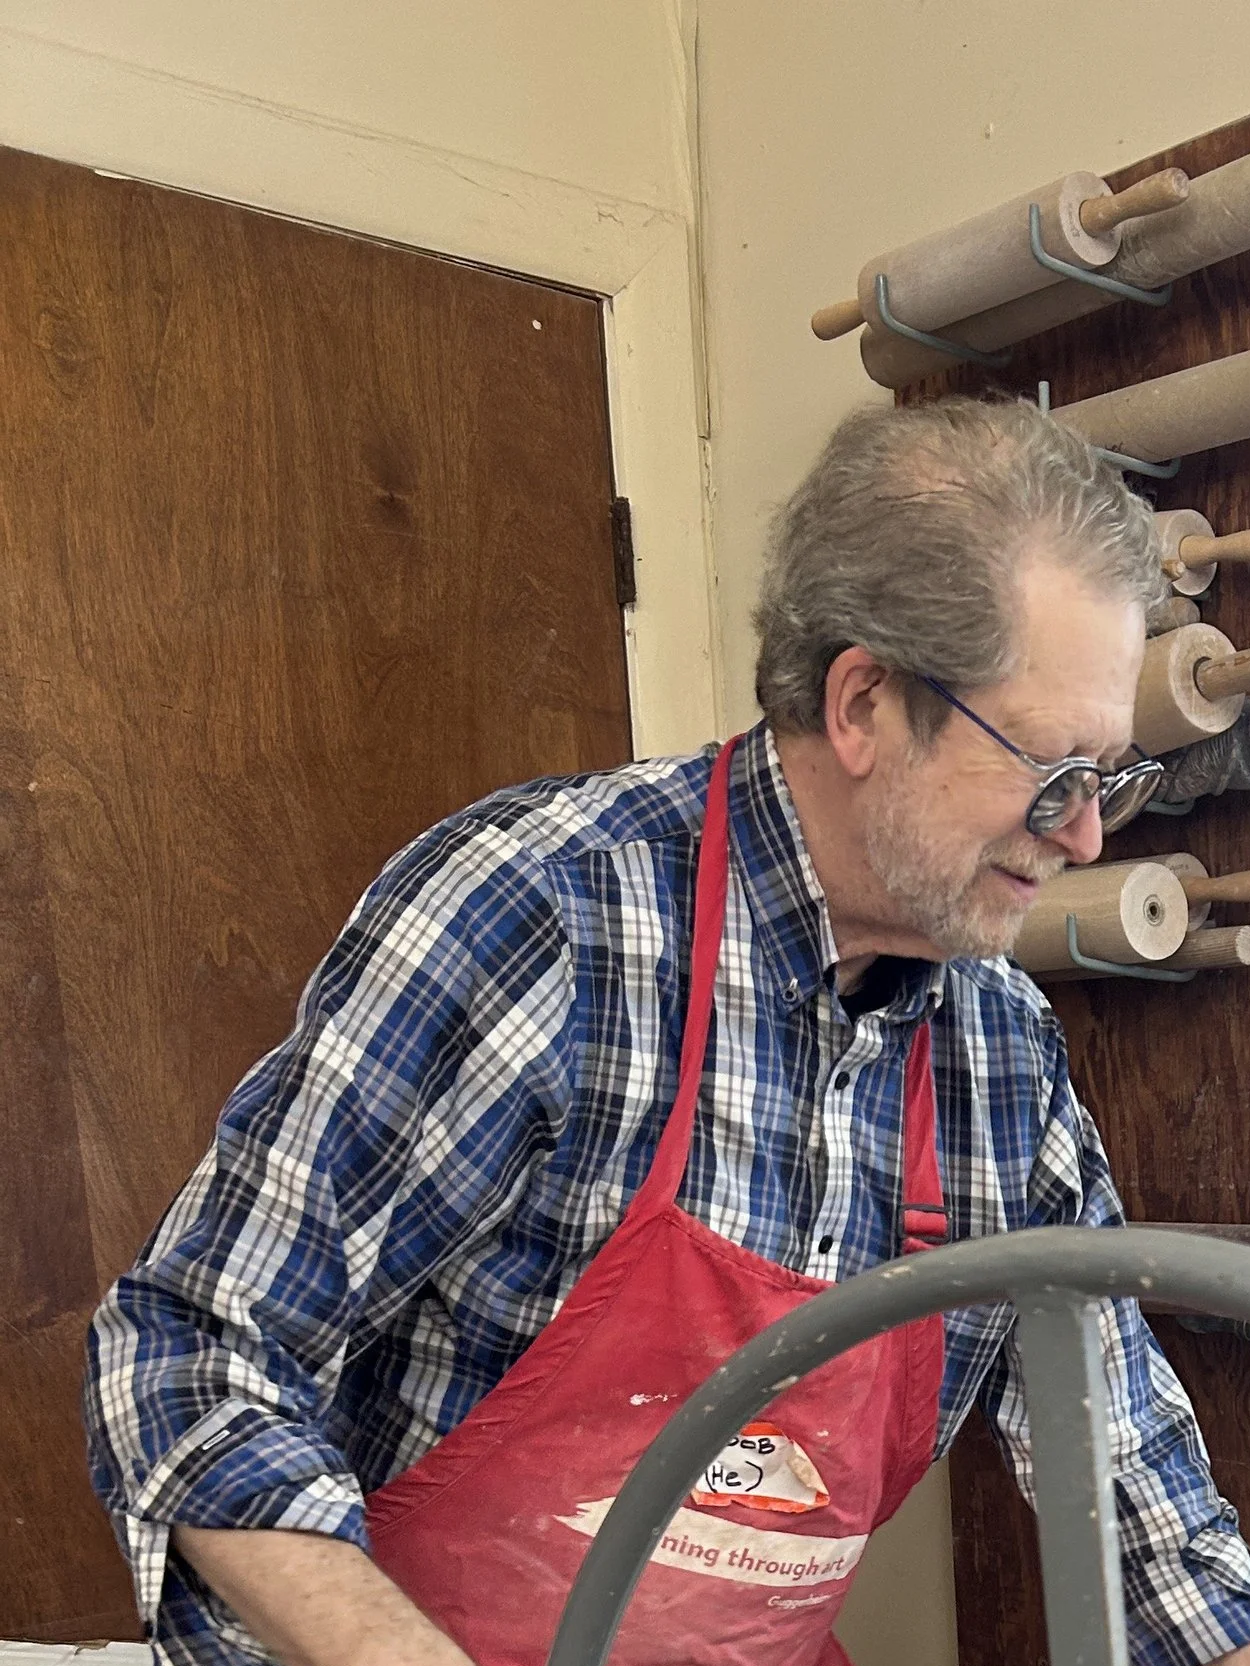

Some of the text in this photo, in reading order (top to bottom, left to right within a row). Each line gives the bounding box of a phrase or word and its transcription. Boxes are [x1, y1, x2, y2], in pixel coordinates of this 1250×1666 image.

[660, 1535, 845, 1581] ning through art
